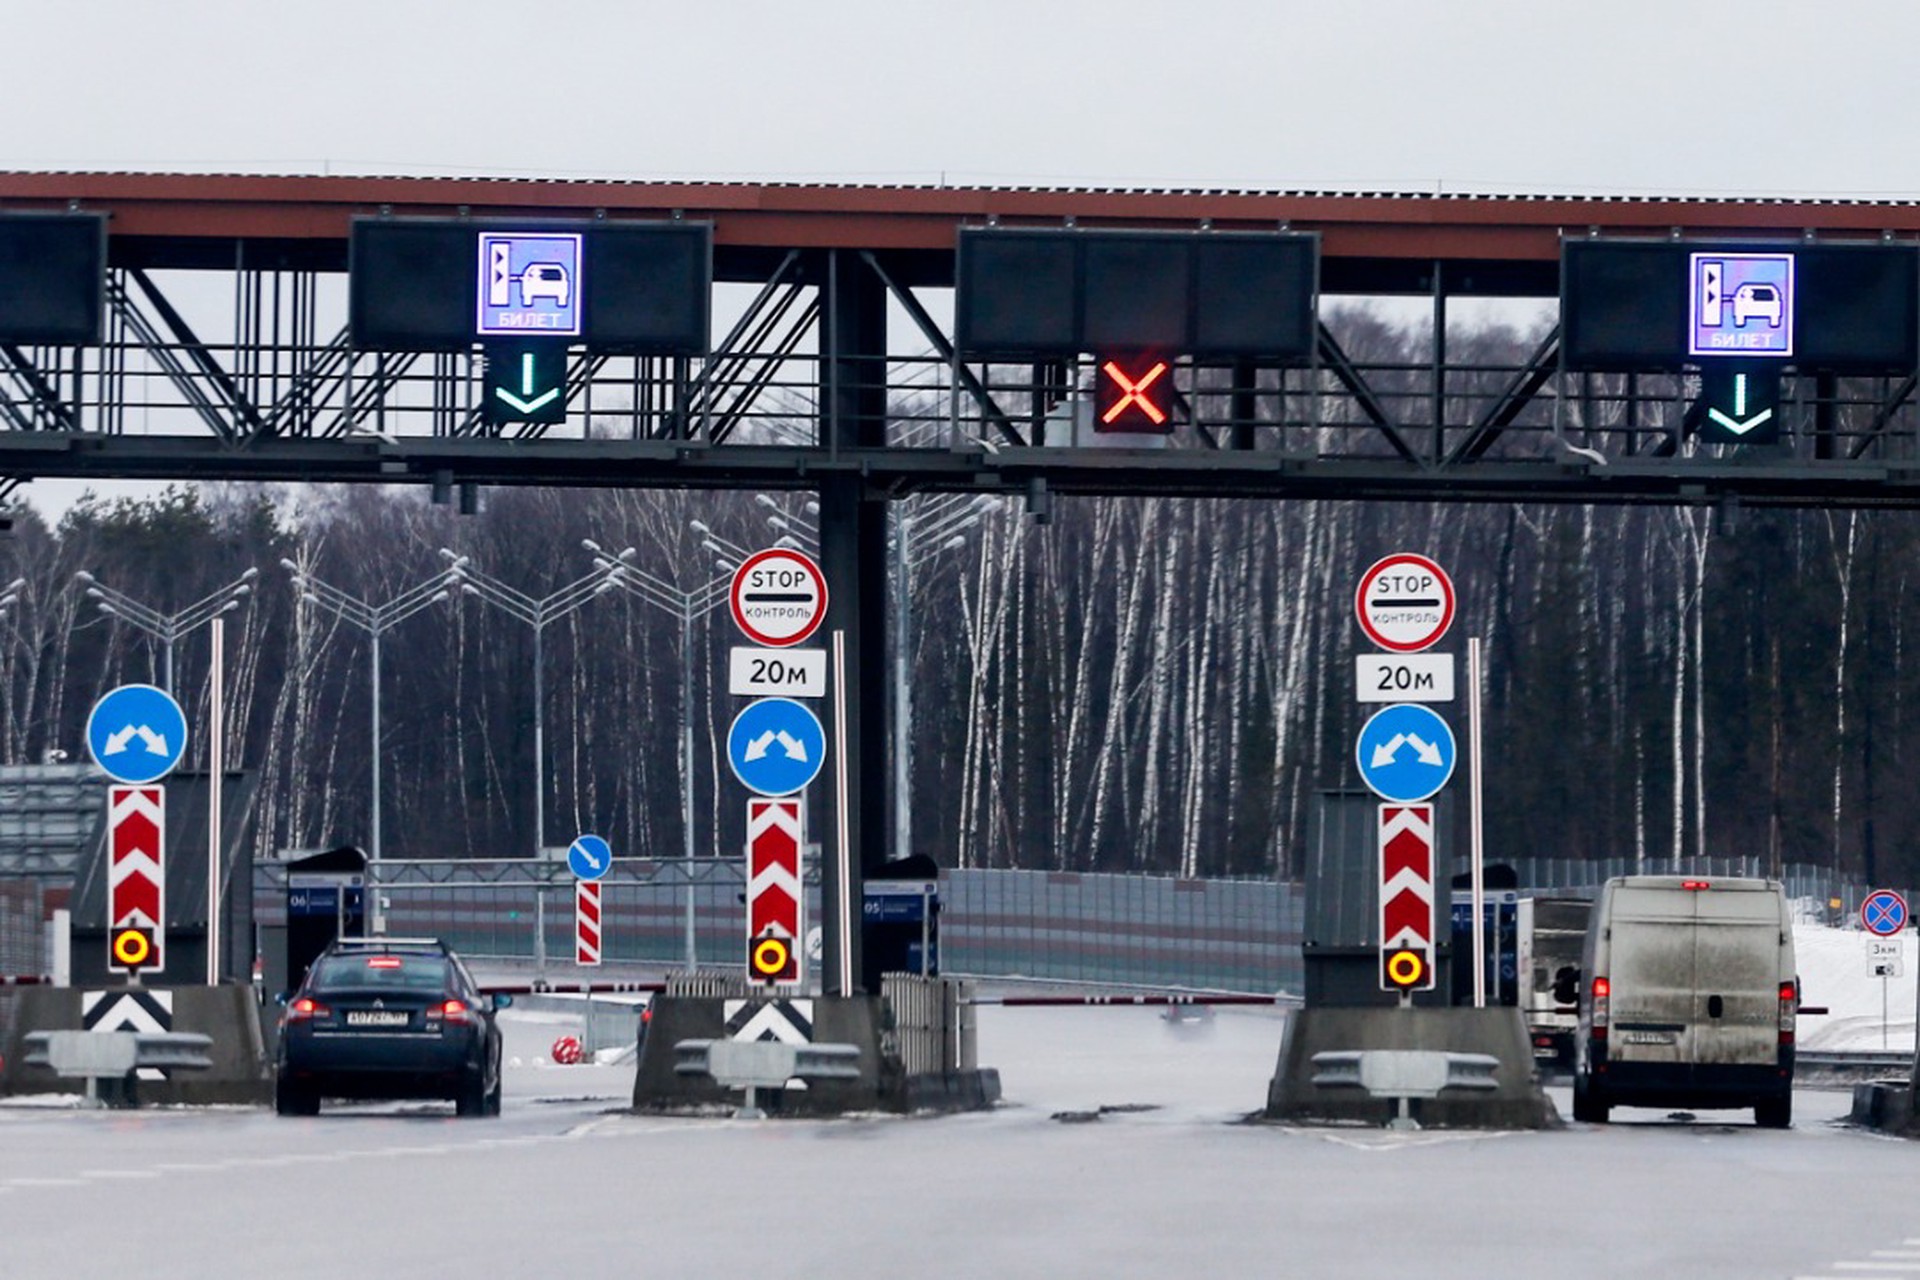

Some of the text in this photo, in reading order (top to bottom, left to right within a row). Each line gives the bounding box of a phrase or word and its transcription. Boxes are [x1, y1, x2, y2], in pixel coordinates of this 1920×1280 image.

[499, 312, 562, 327] БИЛЕТ
[1711, 332, 1774, 347] БИЛЕТ
[751, 570, 806, 588] STOP
[1378, 575, 1432, 593] STOP
[745, 607, 812, 619] КОНТРОЛЬ
[1373, 612, 1440, 624] КОНТРОЛЬ
[290, 894, 306, 907] 06
[864, 901, 880, 914] 05
